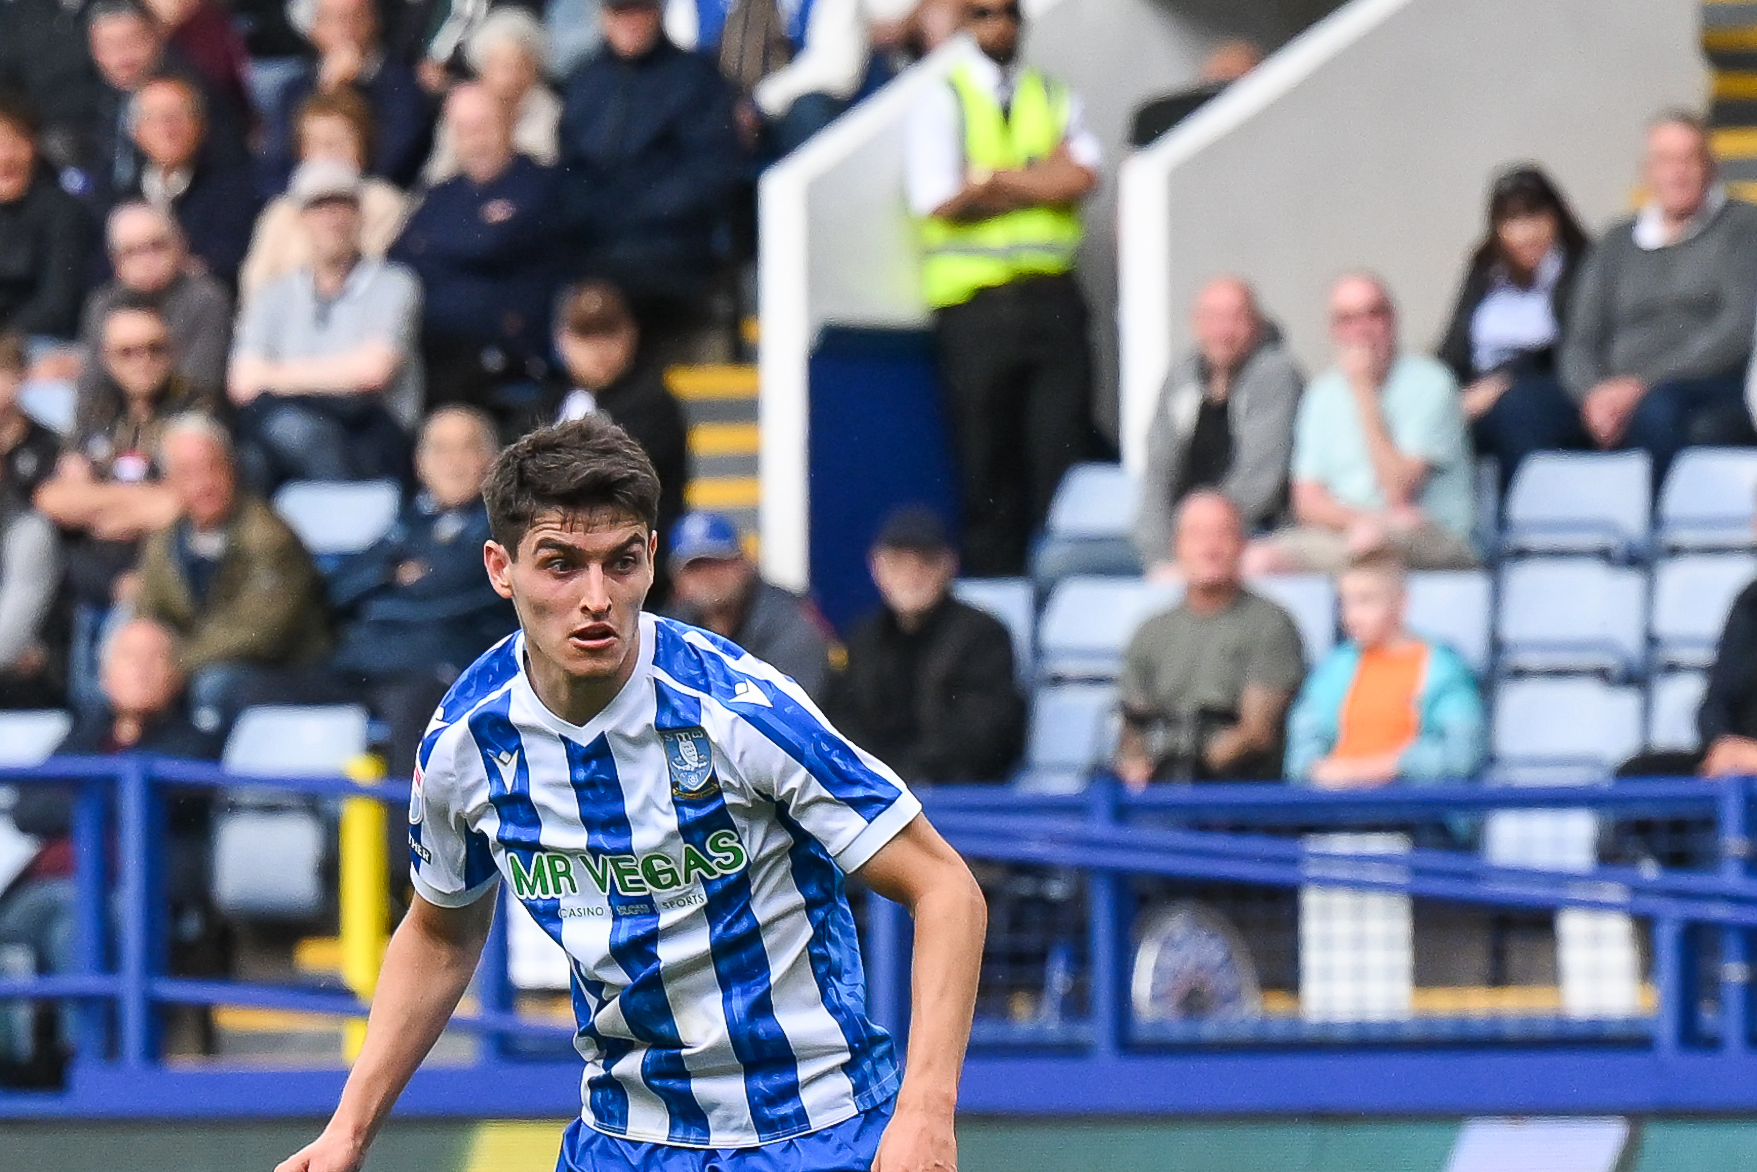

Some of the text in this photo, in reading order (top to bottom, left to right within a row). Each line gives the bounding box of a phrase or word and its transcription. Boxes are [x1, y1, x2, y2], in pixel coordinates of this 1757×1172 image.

[507, 830, 748, 899] MR VEGAS
[558, 906, 604, 919] CASINO
[661, 894, 705, 911] SPORTS
